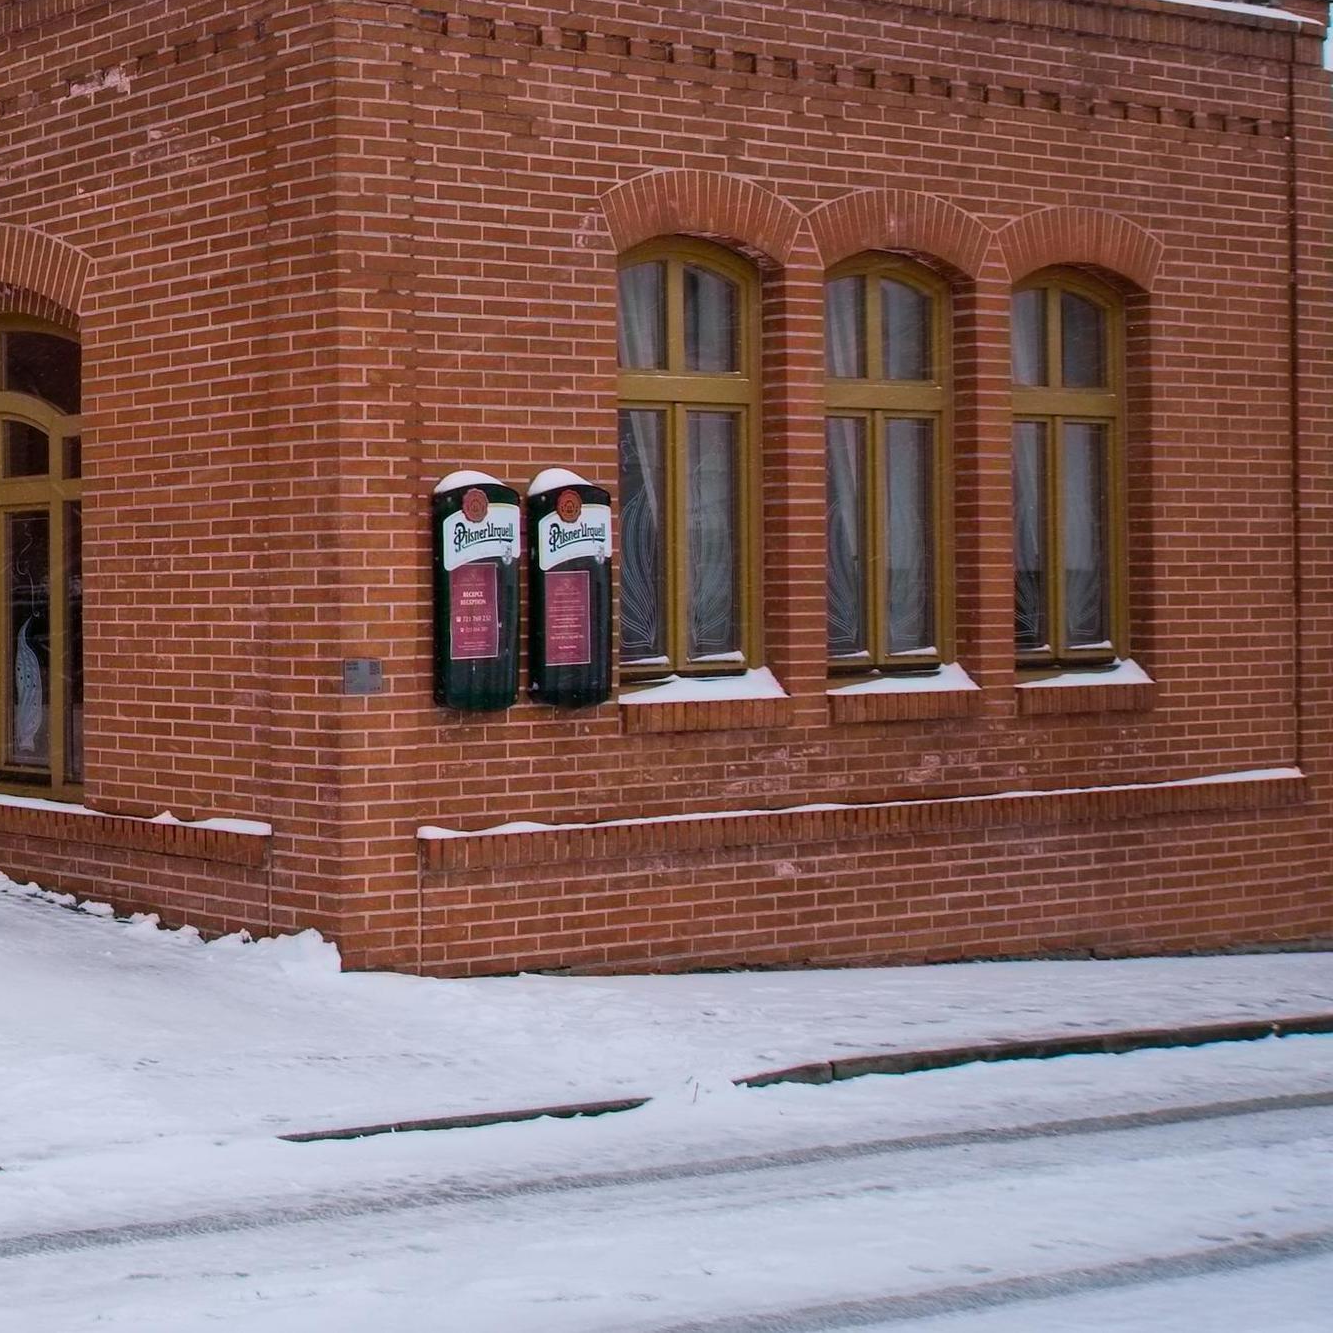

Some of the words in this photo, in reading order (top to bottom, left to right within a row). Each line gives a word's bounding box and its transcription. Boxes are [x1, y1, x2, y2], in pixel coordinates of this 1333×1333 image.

[454, 522, 487, 552] Pilsner
[487, 521, 515, 543] Urquell
[549, 522, 581, 552] Pilsner
[580, 521, 606, 543] Urquell
